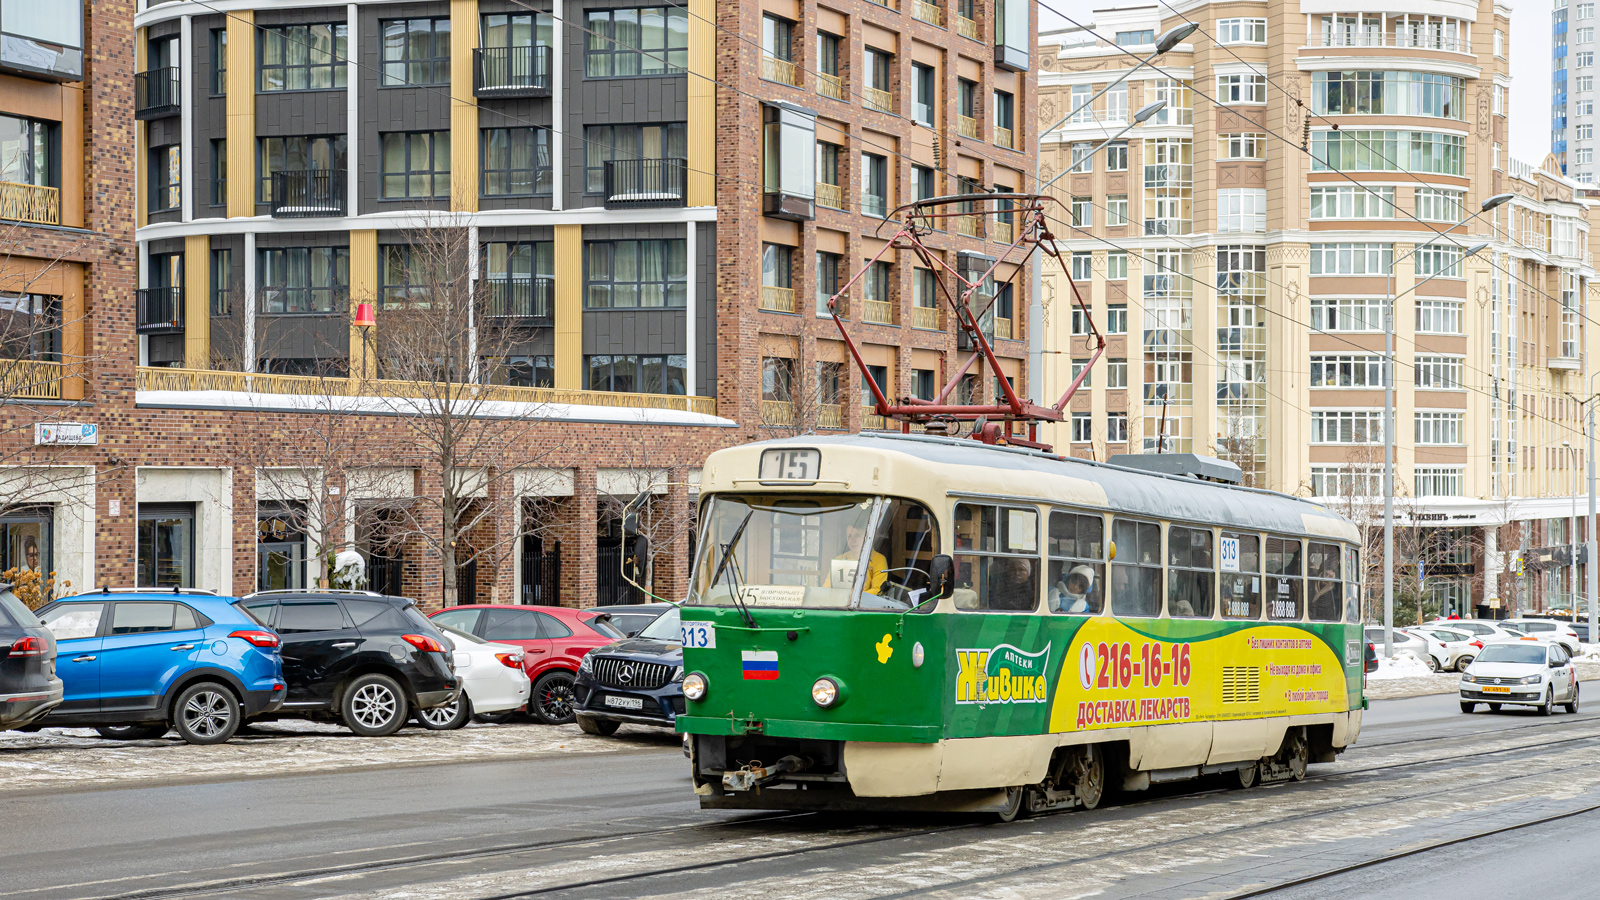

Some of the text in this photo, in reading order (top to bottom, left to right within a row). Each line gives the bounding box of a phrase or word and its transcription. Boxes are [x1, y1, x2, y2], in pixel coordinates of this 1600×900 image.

[775, 452, 808, 479] 15
[1222, 540, 1236, 559] 313
[838, 568, 856, 583] 15
[740, 587, 760, 605] 15
[681, 627, 708, 647] 313
[1251, 636, 1259, 650] Без
[1259, 639, 1275, 649] лишних
[1275, 639, 1295, 649] контактов
[1299, 639, 1312, 649] аптеке
[1097, 642, 1191, 689] 216-16-16
[1269, 662, 1276, 676] Не
[1276, 665, 1291, 678] выходя
[1310, 661, 1322, 678] офиса
[956, 650, 1046, 703] Живика
[1292, 688, 1304, 702] любой
[1304, 688, 1316, 705] район
[1076, 697, 1191, 729] ДОСТАВКА ЛЕКАРСТВ
